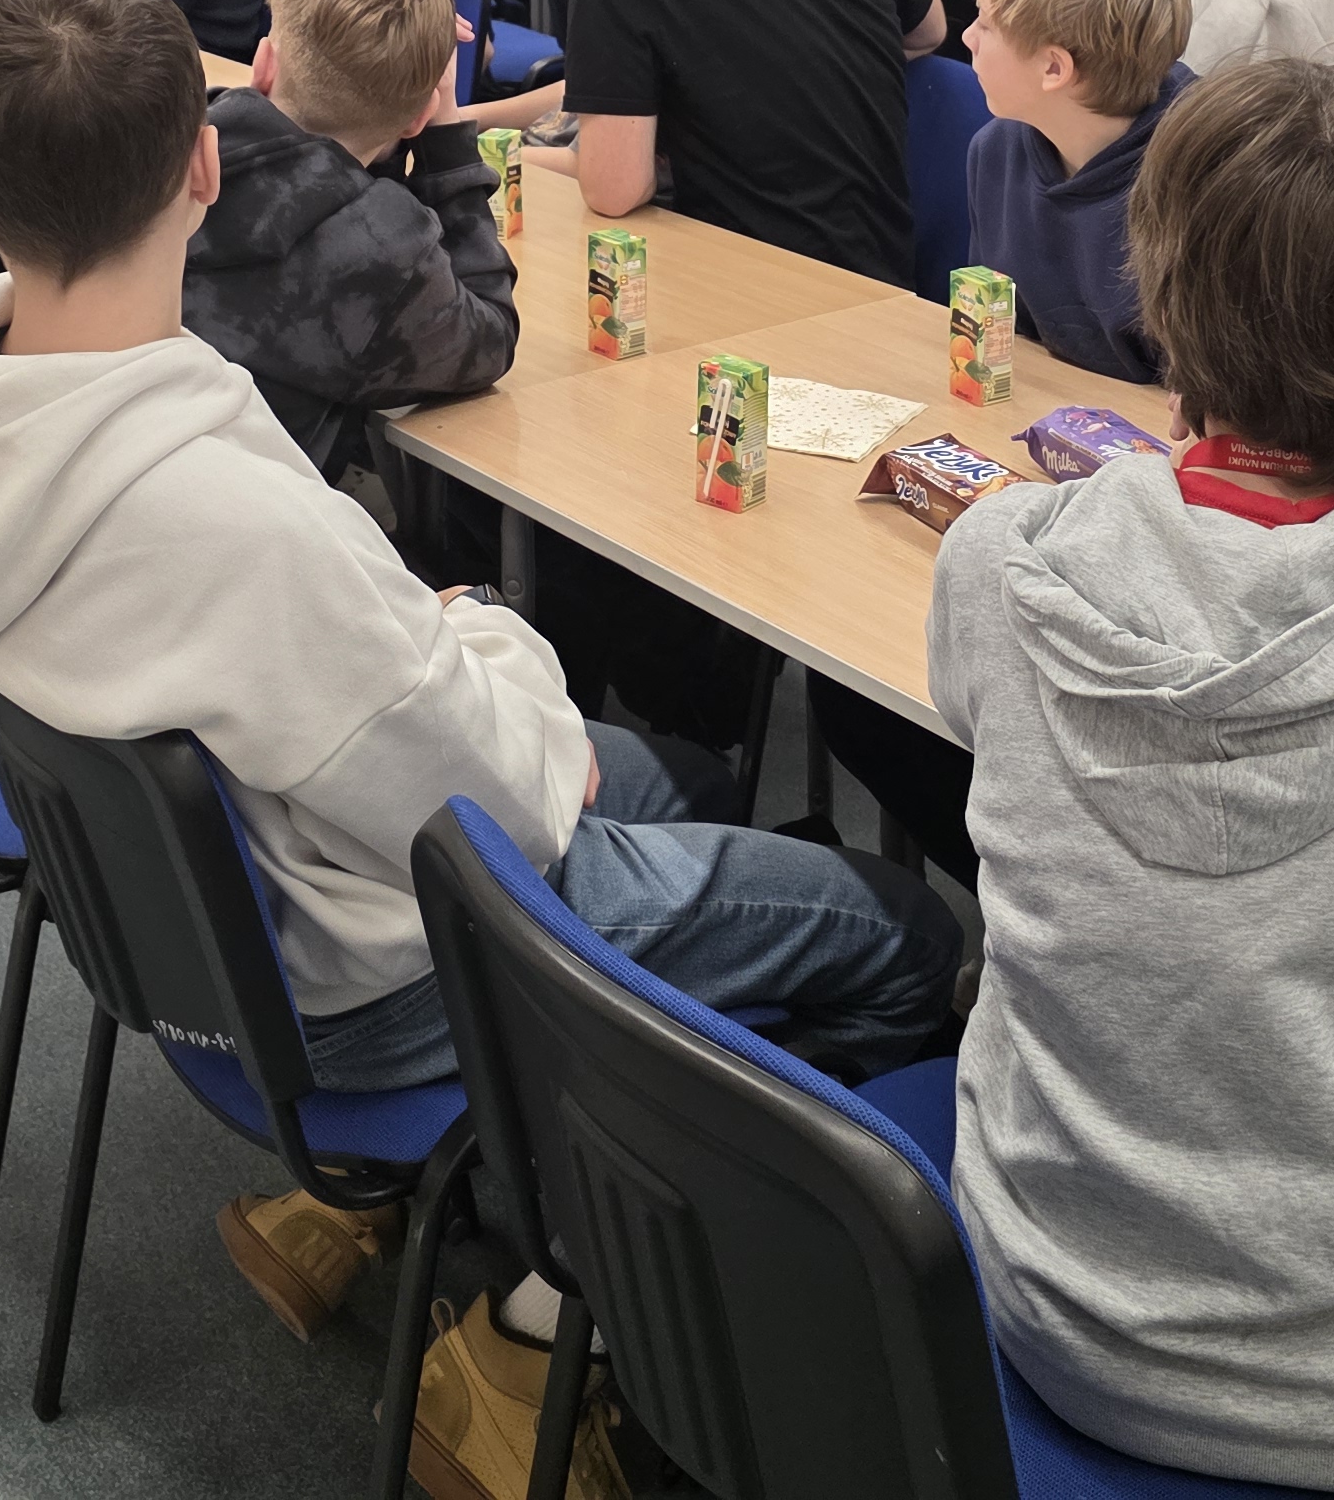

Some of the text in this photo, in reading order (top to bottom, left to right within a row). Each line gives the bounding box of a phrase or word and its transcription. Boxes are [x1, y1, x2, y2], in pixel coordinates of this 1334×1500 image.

[897, 440, 1007, 482] Jeżyki
[1041, 445, 1080, 474] Milka
[1228, 456, 1312, 474] CENTRUM NAUKI
